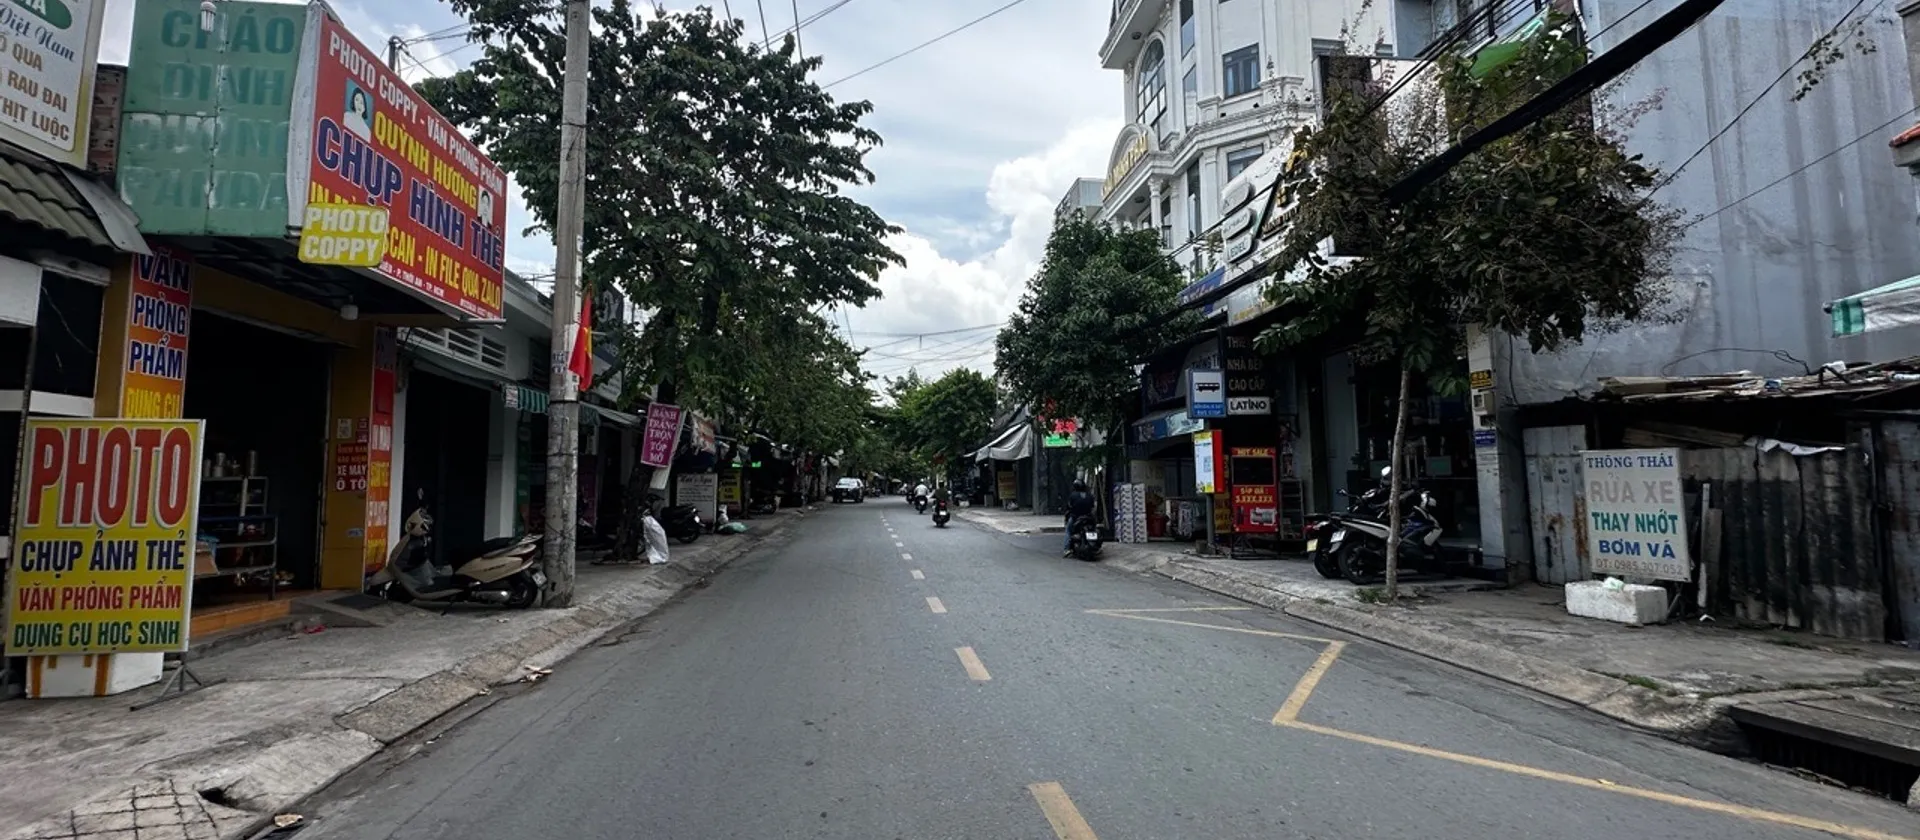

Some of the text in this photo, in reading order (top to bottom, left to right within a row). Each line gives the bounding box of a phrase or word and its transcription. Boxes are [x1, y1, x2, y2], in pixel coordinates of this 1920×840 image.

[12, 42, 42, 72] QUA
[35, 27, 76, 63] Nam
[8, 69, 38, 98] RAU
[0, 94, 69, 141] HỊT LUỘC
[328, 30, 376, 90] PHOTO
[379, 74, 419, 126] COPPY
[427, 114, 449, 150] VĂN
[449, 135, 480, 182] PHÒNG
[374, 111, 477, 211] QUỲNH HƯƠNG
[316, 116, 404, 206] CHỤP
[409, 177, 466, 251] HÌNH
[470, 218, 502, 275] THẺ
[305, 206, 387, 233] PHOTO
[304, 235, 379, 262] COPPY
[138, 246, 190, 293] VĂN
[425, 245, 438, 279] IN
[439, 253, 461, 290] FILE
[461, 266, 480, 300] QUA
[480, 276, 501, 311] ZALO
[133, 292, 188, 336] PHÒNG
[128, 333, 184, 380] PHẨM
[1227, 356, 1247, 371] NHÀ
[1229, 377, 1247, 391] CAO
[652, 407, 677, 420] BÁNH
[1230, 399, 1267, 411] LATINO
[649, 418, 677, 431] TRÁNG
[23, 425, 192, 528] PHOTO
[336, 476, 367, 491] Ô TÔ
[337, 464, 347, 476] XE
[1590, 472, 1675, 504] RỬA XE
[1592, 508, 1679, 535] THAY NHỚT
[21, 529, 186, 578] CHỤP ẢNH THẺ
[1599, 538, 1676, 559] BƠM VÁ
[19, 576, 182, 611] VĂN PHÒNG PHẨM
[13, 620, 180, 652] DỤNG CỤ HỌC SINH
